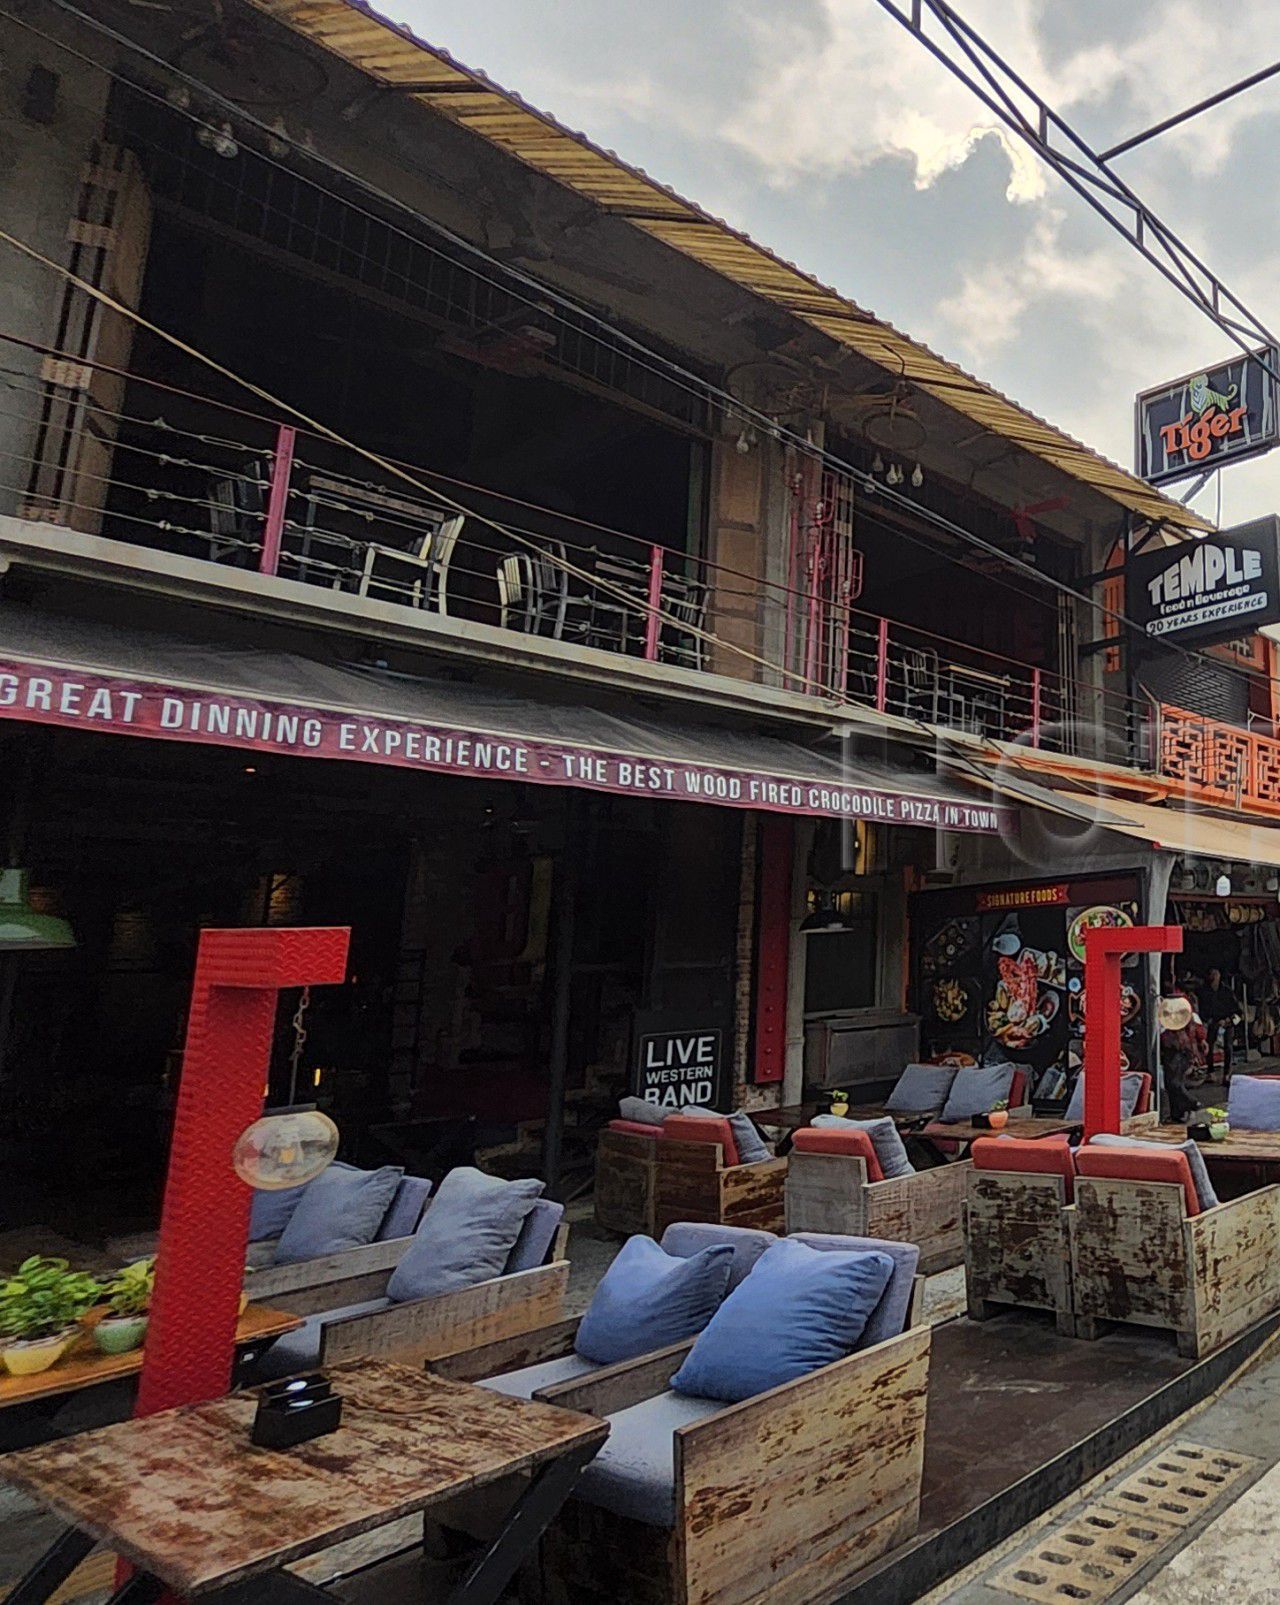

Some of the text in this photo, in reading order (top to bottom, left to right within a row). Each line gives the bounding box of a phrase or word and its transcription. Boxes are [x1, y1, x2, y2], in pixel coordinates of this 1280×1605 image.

[1159, 403, 1248, 460] Tiger
[1147, 543, 1262, 606] TEMPLE
[1149, 596, 1264, 635] 20 YEARS EXPERIENCE
[0, 673, 144, 723] GREAT
[160, 697, 323, 748] DINNING
[338, 723, 529, 773] EXPERIENCE
[562, 754, 608, 783] THE
[618, 762, 675, 791] BEST
[685, 771, 742, 800] WOOD
[750, 780, 802, 808] FIRED
[808, 788, 896, 818] CROCODILE
[901, 800, 940, 824] PIZZA
[944, 807, 960, 827] IN
[963, 808, 998, 830] TOWN
[987, 888, 1058, 908] SIGNATURE FOODS
[646, 1036, 716, 1068] LIVE
[645, 1065, 714, 1085] WESTERN
[644, 1080, 713, 1108] BAND
